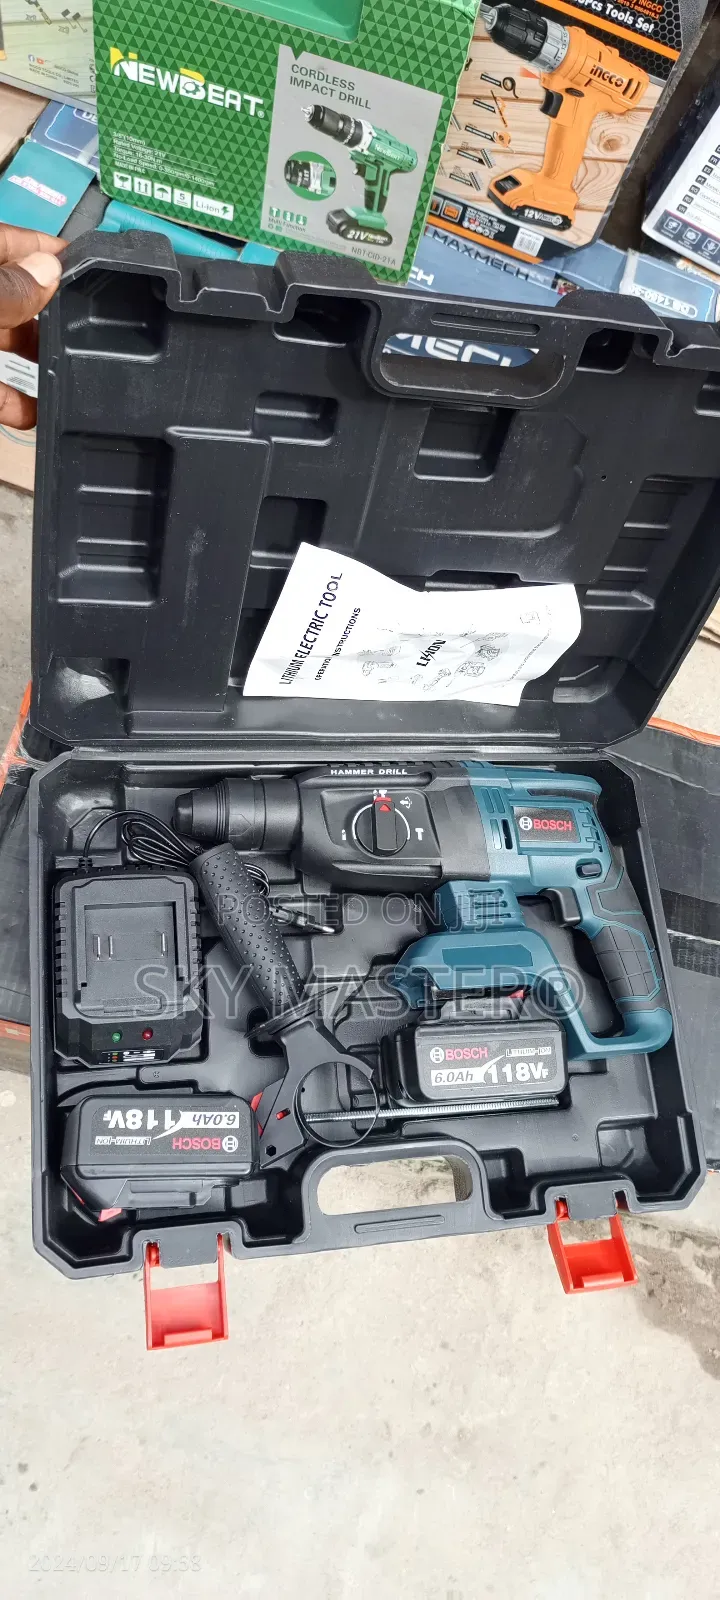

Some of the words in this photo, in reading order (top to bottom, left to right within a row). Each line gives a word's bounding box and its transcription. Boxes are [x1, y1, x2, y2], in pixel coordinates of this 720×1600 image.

[605, 3, 634, 25] Tools
[635, 17, 655, 33] Set
[291, 63, 356, 91] CORDLESS
[289, 76, 336, 98] IMPACT
[338, 91, 372, 110] DRILL
[179, 192, 185, 200] 5
[524, 208, 542, 220] 12V
[347, 230, 369, 241] 21V
[432, 229, 530, 281] MAXMECH
[295, 609, 329, 659] ELECTRIC
[318, 573, 343, 608] TOOL
[533, 818, 573, 831] BOSCH
[445, 1047, 489, 1061] BOSCH
[434, 1070, 474, 1084] 6.0Ah
[192, 1113, 237, 1126] 6.0Ah
[172, 1137, 221, 1150] BOSCH
